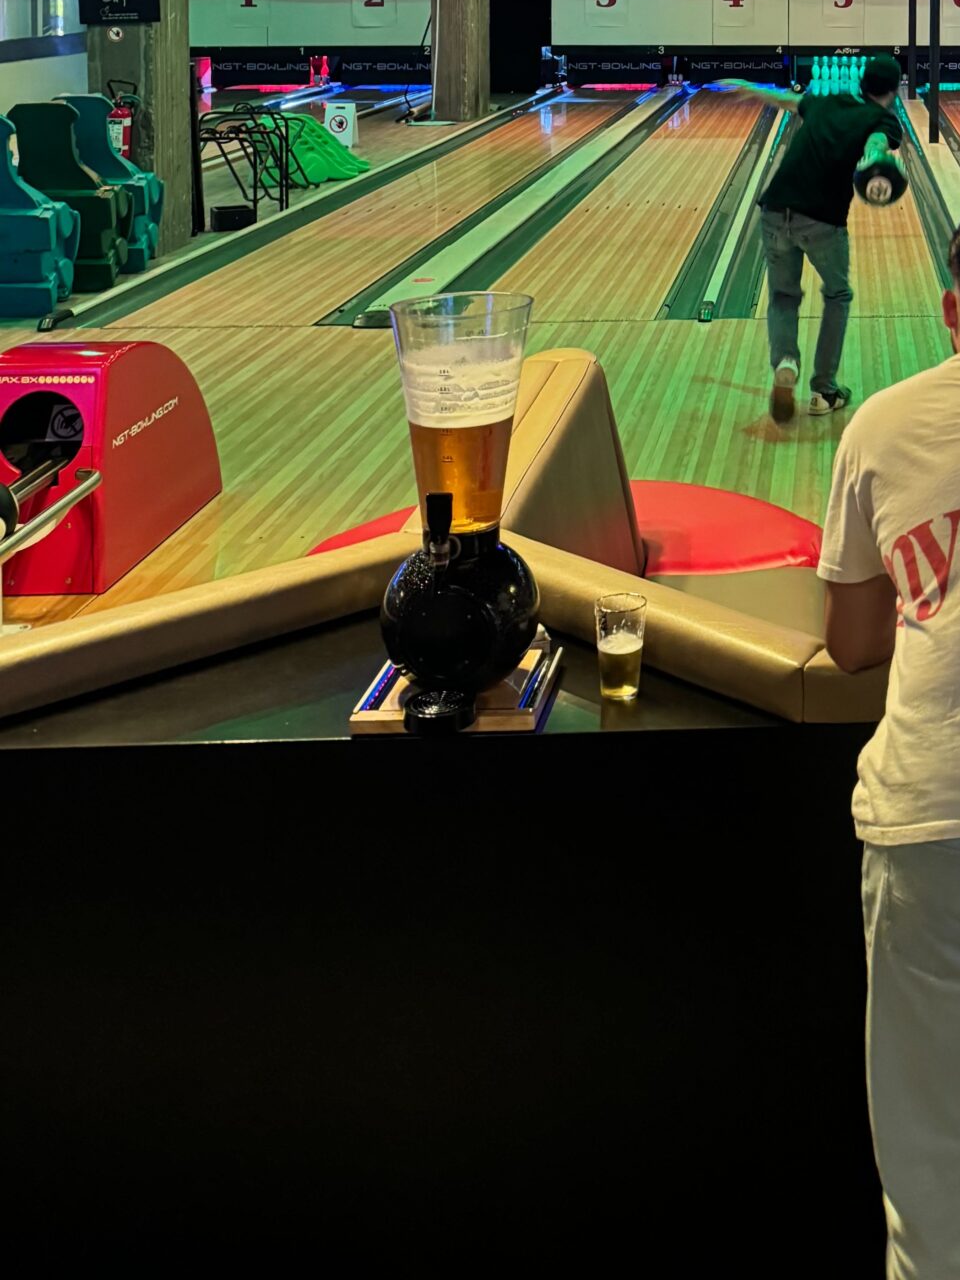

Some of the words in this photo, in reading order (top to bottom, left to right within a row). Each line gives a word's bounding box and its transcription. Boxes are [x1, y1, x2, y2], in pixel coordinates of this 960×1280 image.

[300, 47, 304, 55] 1
[423, 46, 431, 55] 2
[658, 46, 665, 55] 3
[775, 46, 783, 54] 4
[893, 46, 900, 55] 5
[342, 62, 431, 71] NGT-BOWLIN
[0, 376, 20, 384] AX
